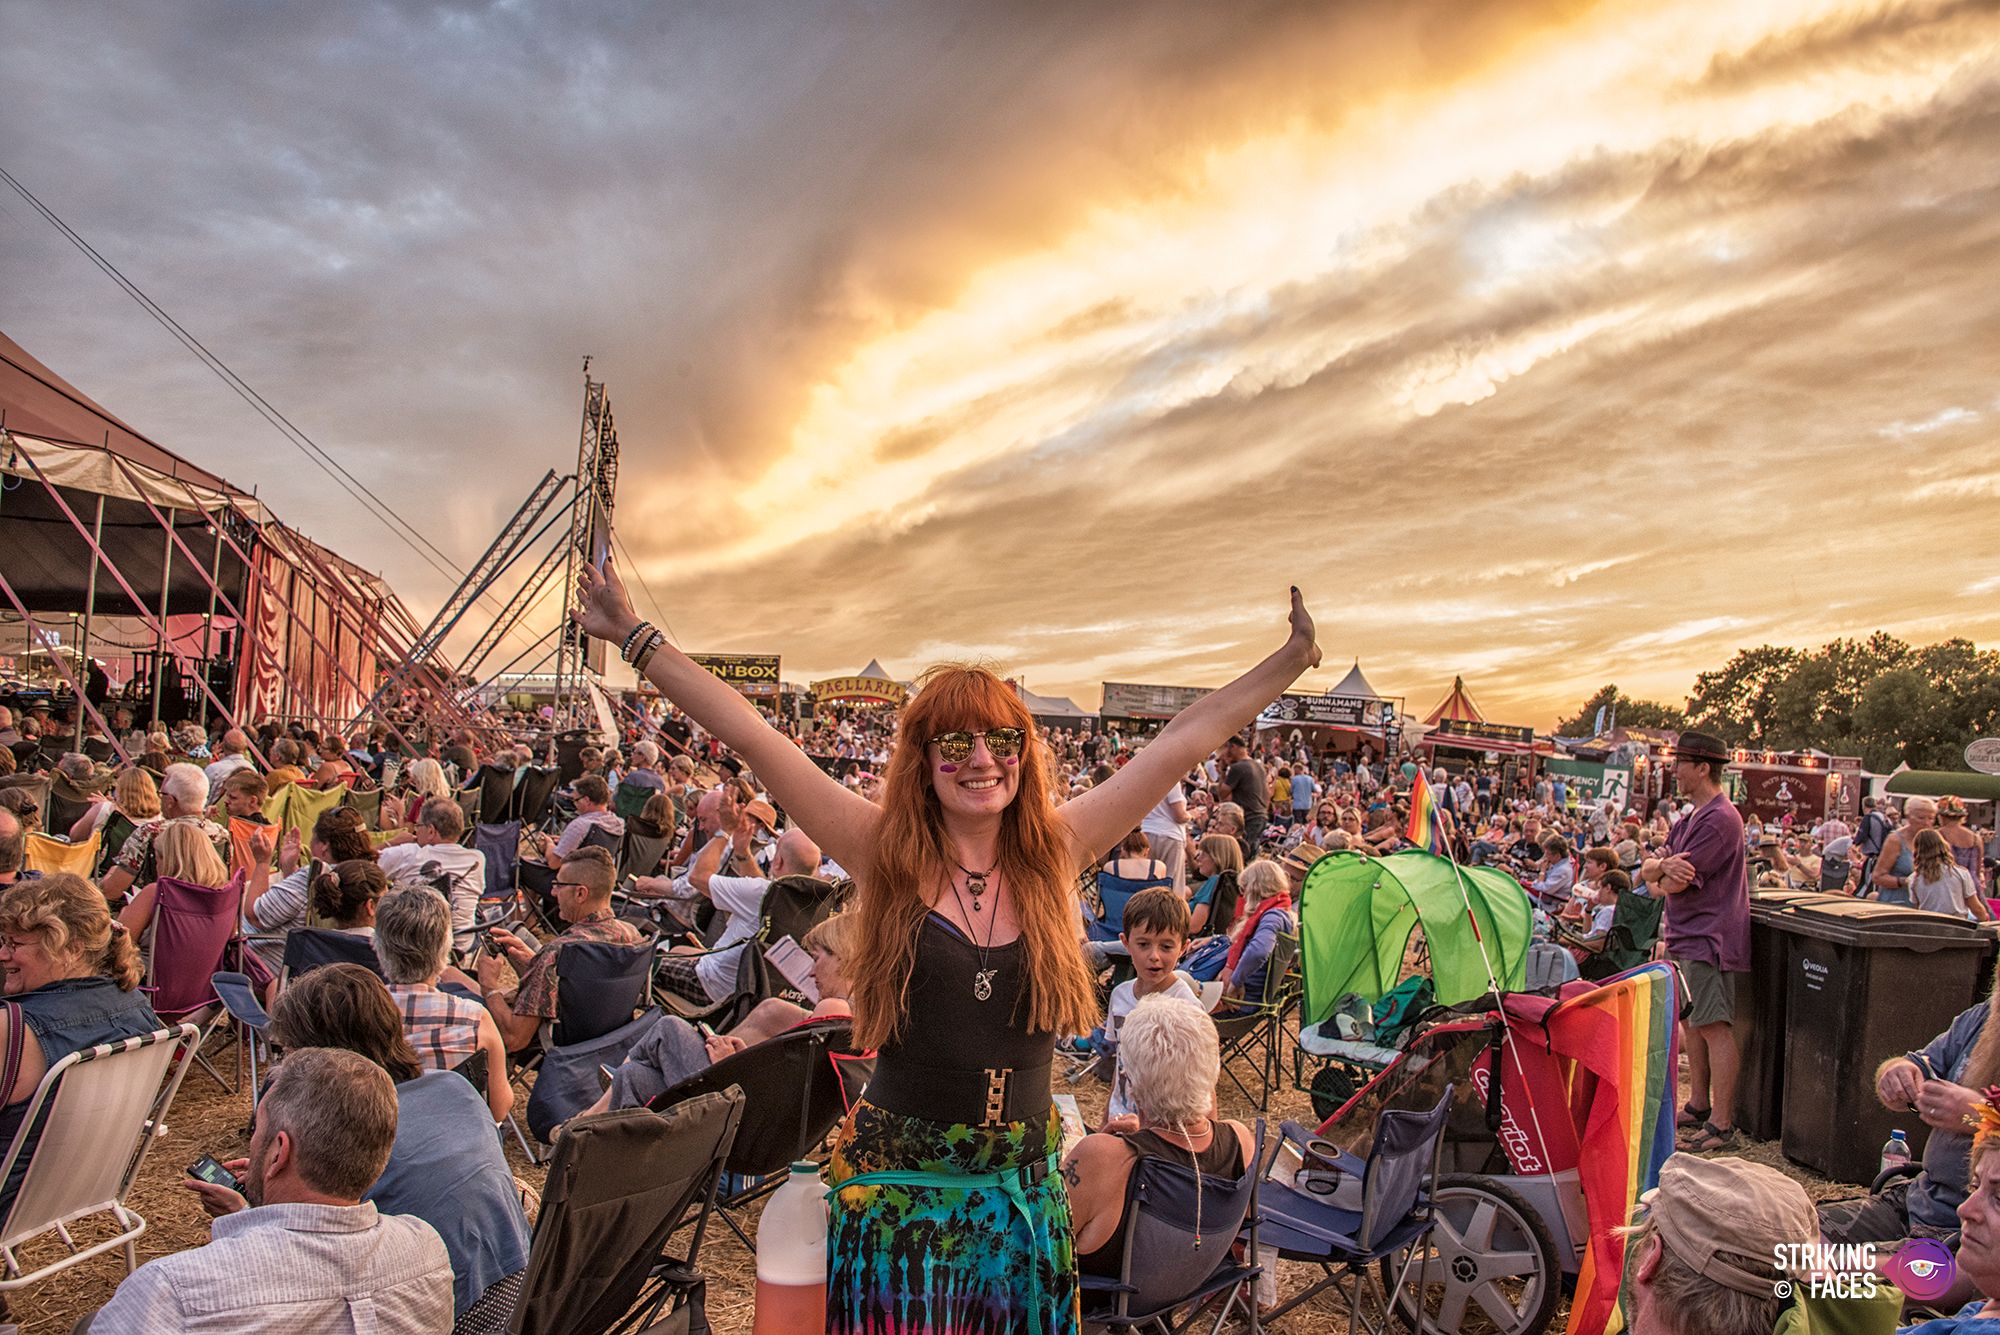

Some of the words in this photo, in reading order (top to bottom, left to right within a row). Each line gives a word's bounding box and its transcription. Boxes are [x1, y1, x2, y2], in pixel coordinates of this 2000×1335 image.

[735, 665, 777, 678] BOX
[816, 679, 901, 698] PAELLARIA
[1552, 772, 1600, 787] MRGENCY
[1474, 1068, 1542, 1172] Cariot
